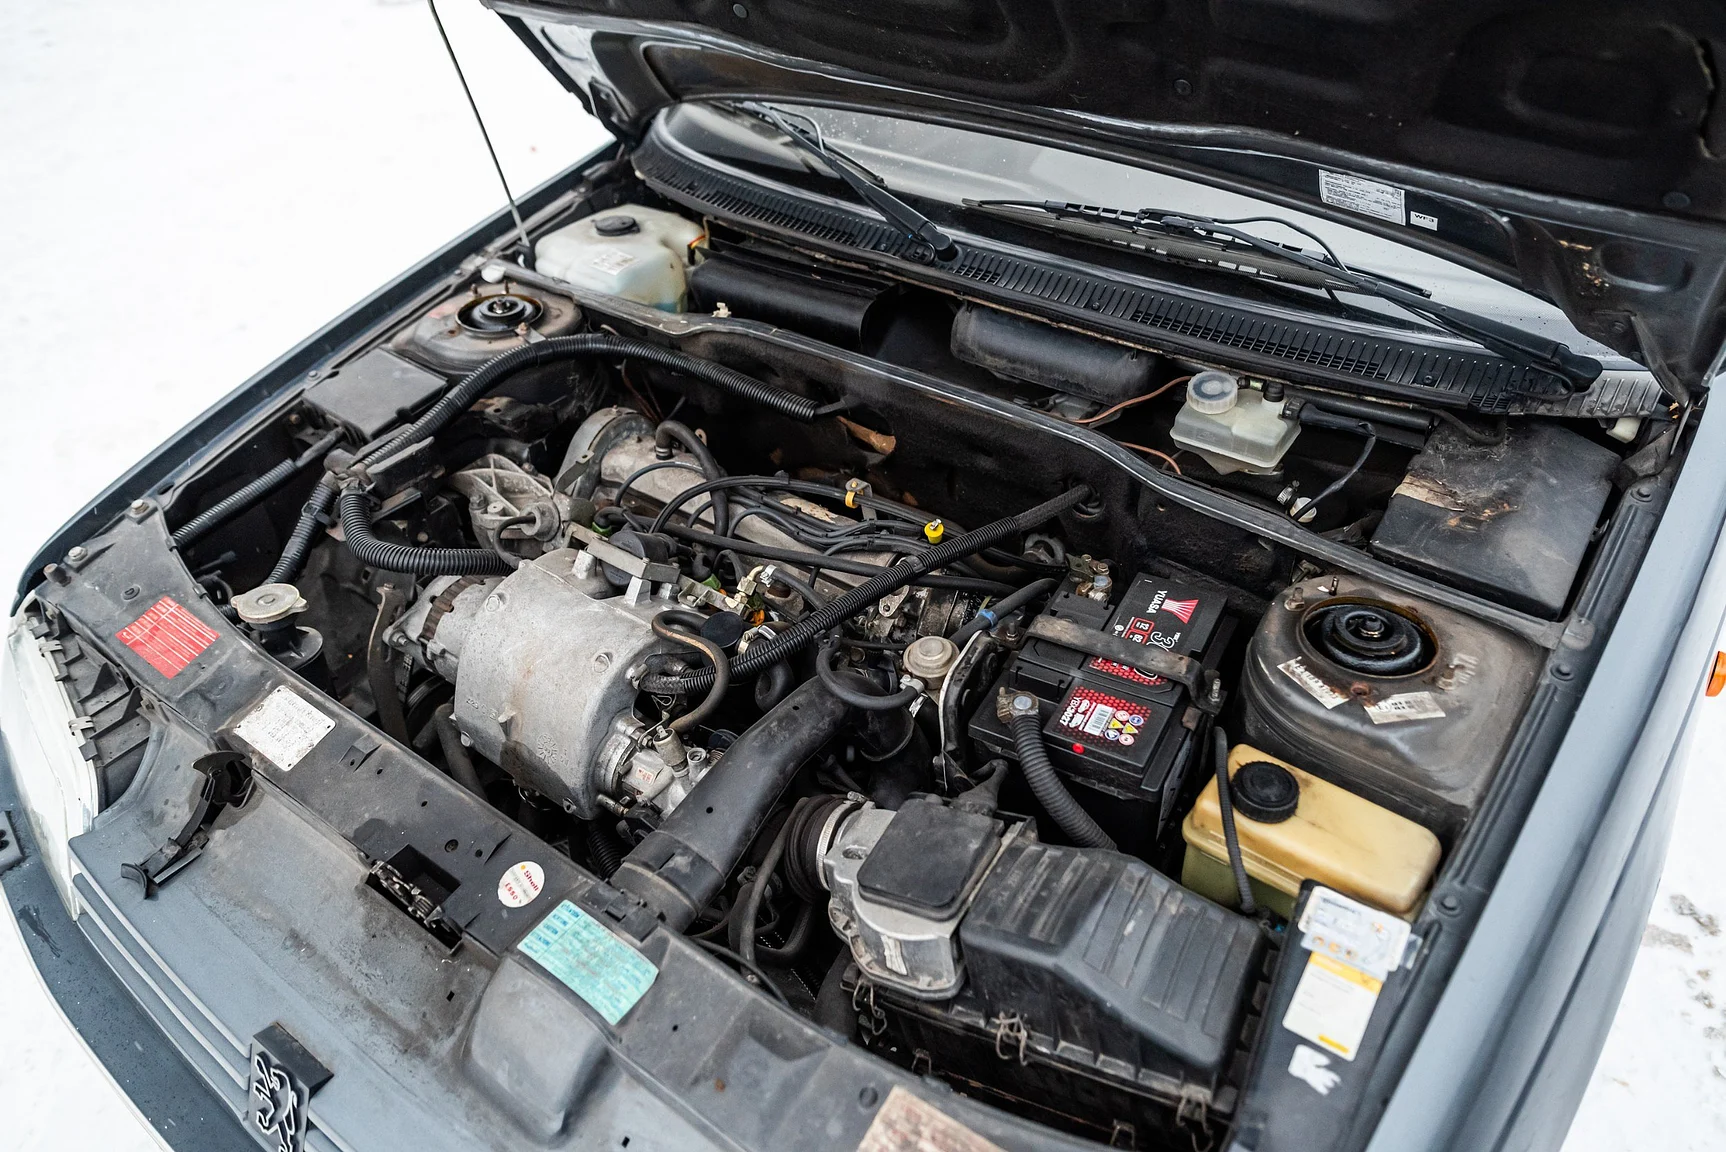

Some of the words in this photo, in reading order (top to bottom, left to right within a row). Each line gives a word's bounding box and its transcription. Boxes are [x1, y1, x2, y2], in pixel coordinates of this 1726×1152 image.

[1146, 590, 1168, 614] YUASA
[1060, 696, 1082, 726] YBX3027
[524, 870, 539, 892] Shell
